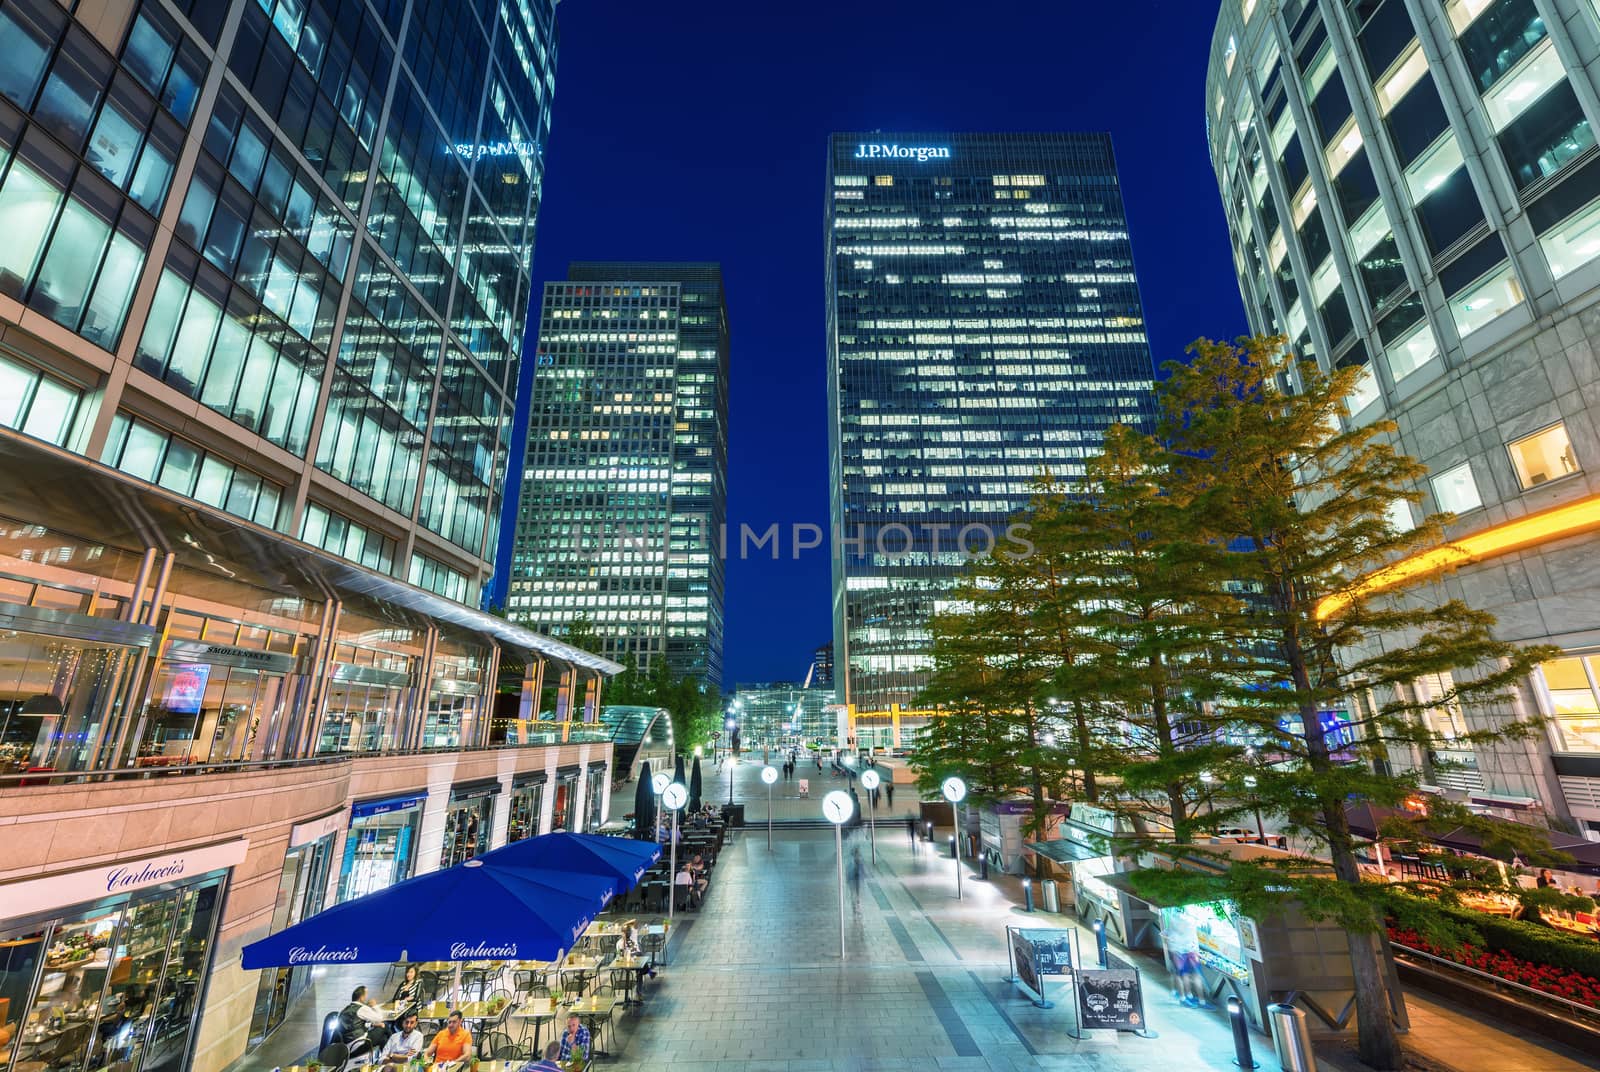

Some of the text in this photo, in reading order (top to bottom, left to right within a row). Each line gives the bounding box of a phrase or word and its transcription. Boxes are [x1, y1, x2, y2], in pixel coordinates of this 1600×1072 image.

[855, 144, 951, 162] J.P.Morgan
[107, 859, 184, 892] Carluccio's
[289, 945, 359, 964] Carluccio's
[450, 940, 518, 960] Carluccio's
